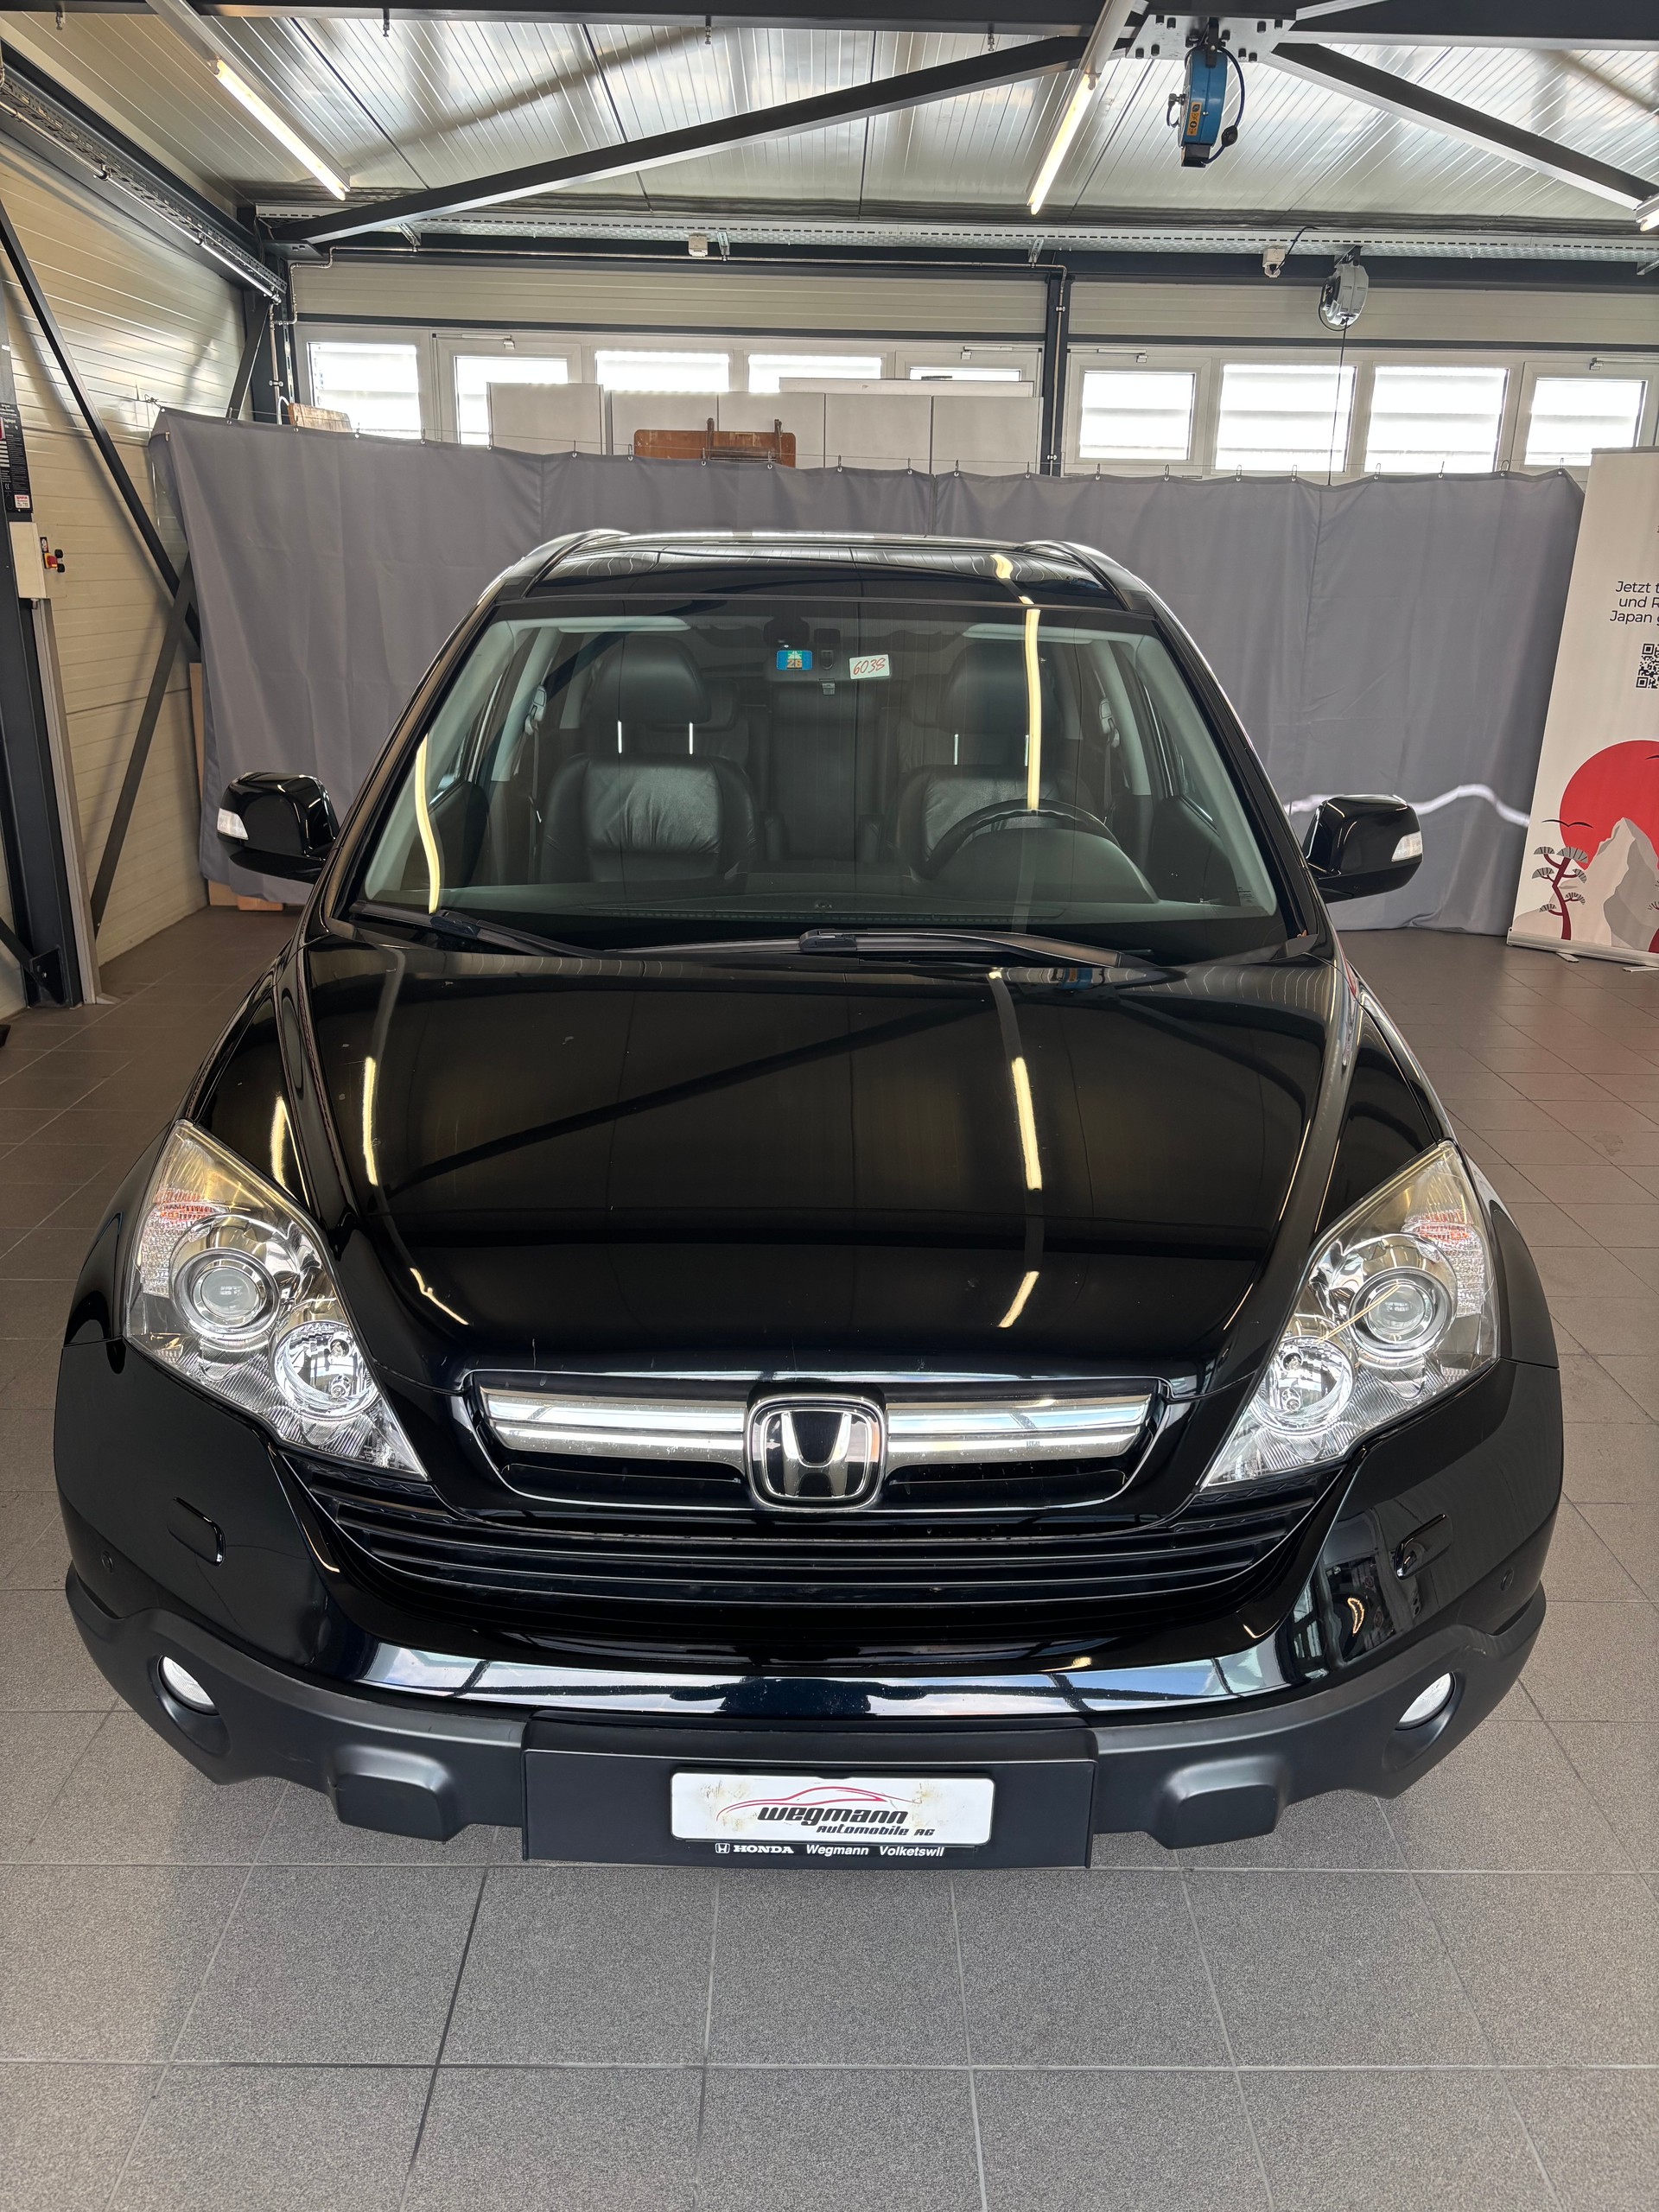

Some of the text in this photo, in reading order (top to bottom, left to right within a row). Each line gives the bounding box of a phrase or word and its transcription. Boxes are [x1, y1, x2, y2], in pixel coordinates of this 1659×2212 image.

[1616, 581, 1651, 594] Jetzt
[1619, 596, 1648, 607] und
[1610, 610, 1653, 625] Japan
[757, 1807, 908, 1826] wegmann
[733, 1844, 945, 1857] HONDA Wegmann Volketswil
